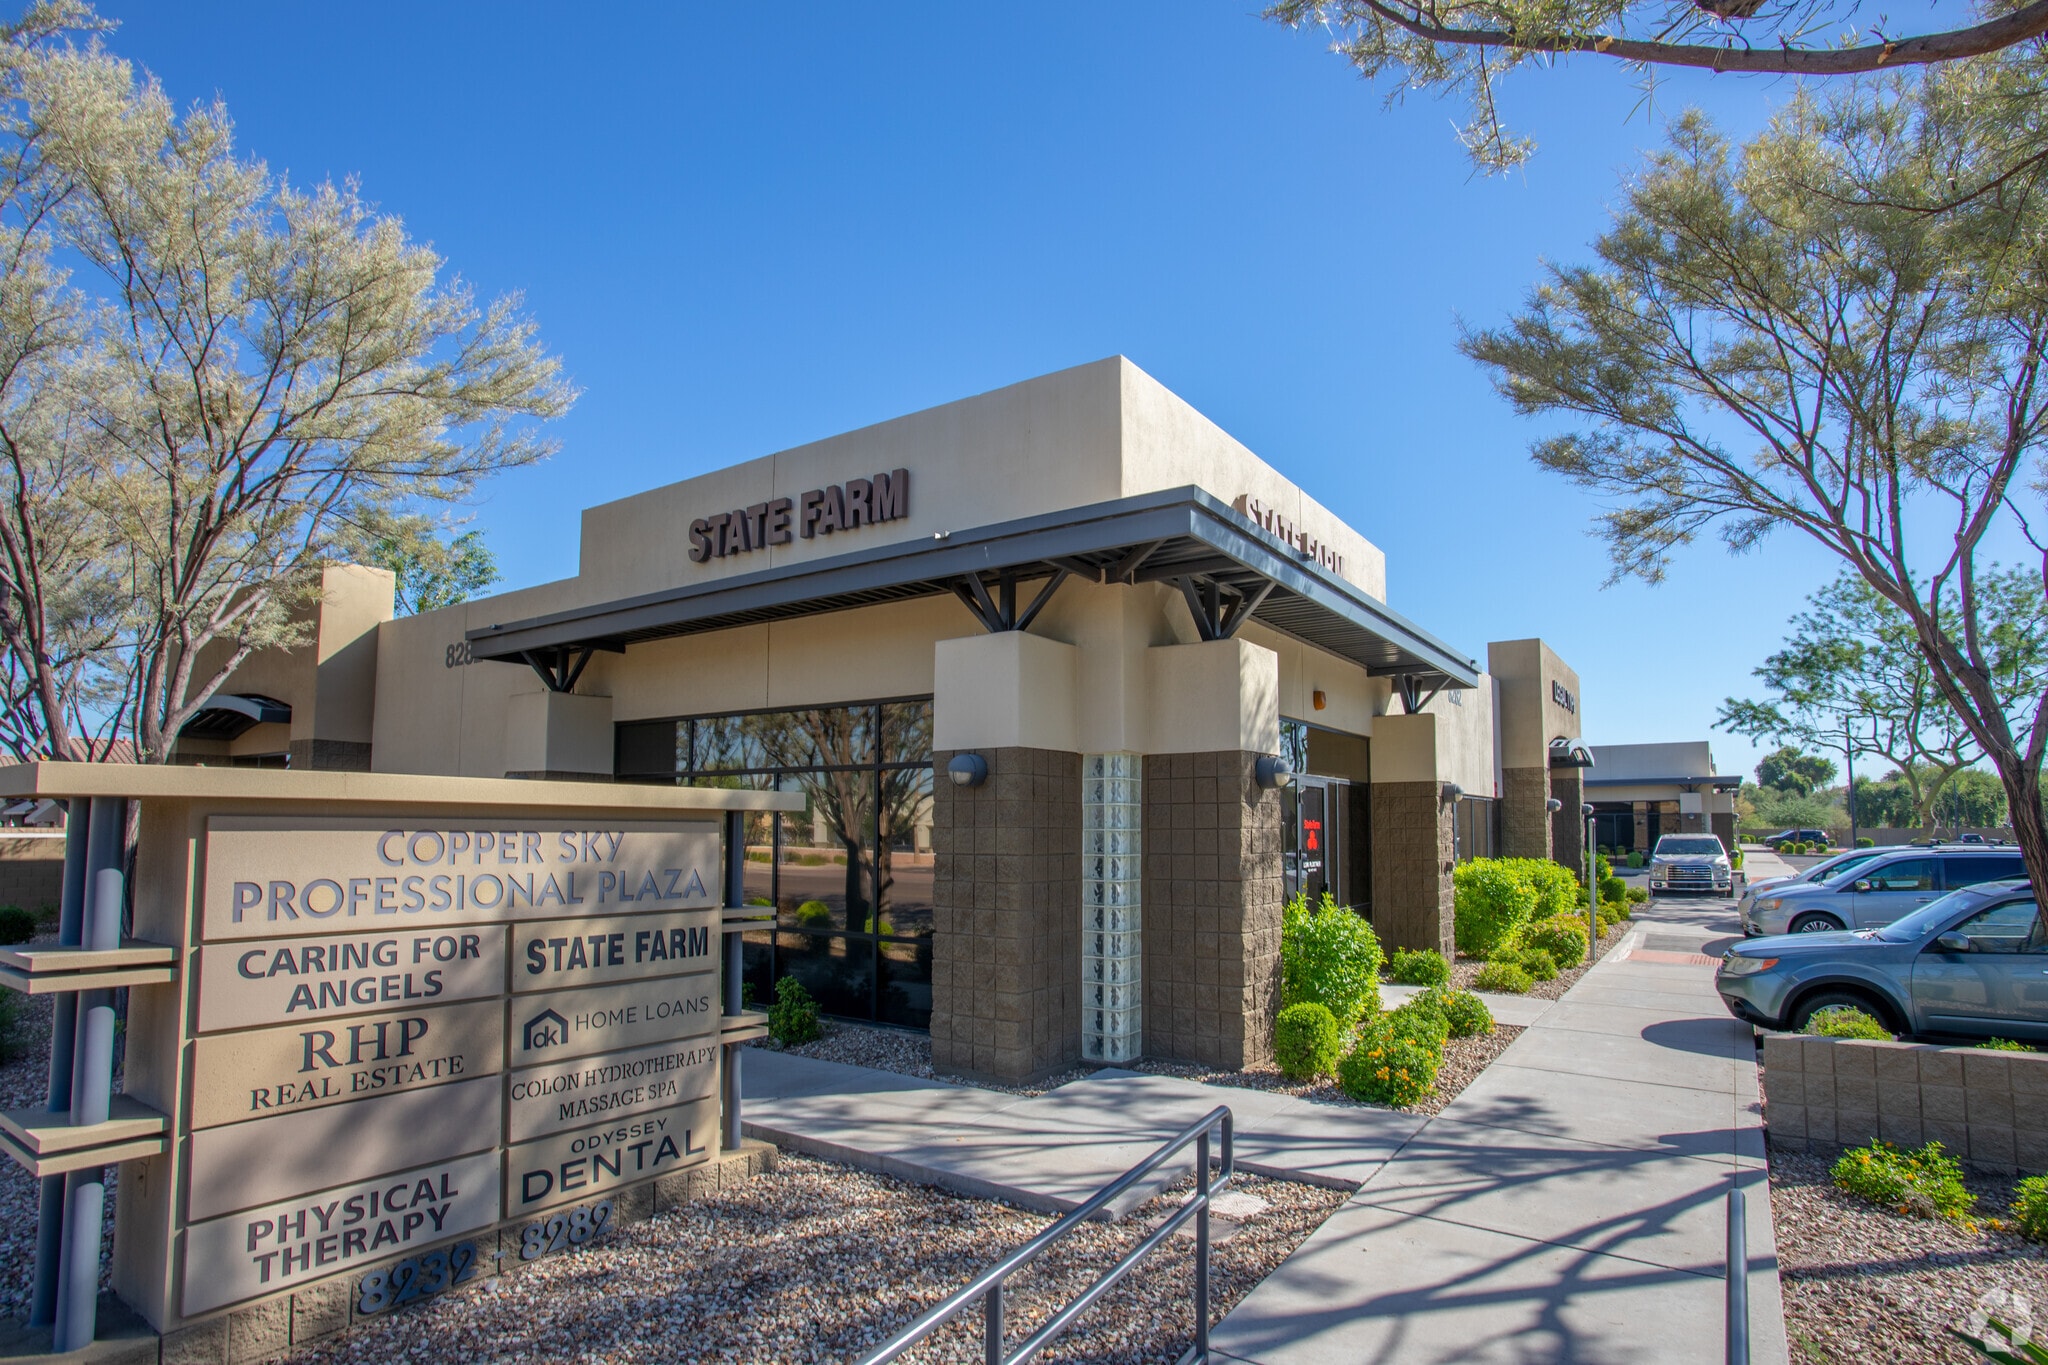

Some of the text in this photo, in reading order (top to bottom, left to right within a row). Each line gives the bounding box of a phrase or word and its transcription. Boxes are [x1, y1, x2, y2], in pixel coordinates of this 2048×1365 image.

[688, 468, 908, 562] STATE FARM
[446, 640, 483, 668] 828
[376, 829, 625, 867] COPPER SKY
[232, 868, 707, 923] PROFESSIONAL PLAZA
[237, 934, 481, 980] CARING FOR
[526, 926, 709, 975] STATE FARM
[285, 970, 443, 1013] ANGELS
[575, 1006, 638, 1032] HOME
[645, 995, 710, 1021] LOANS
[298, 1017, 429, 1073] RHP
[250, 1055, 464, 1111] REAL ESTATE
[511, 1046, 716, 1101] COLON HYDROTHERAPY
[559, 1080, 678, 1121] MASSAGE SPA
[571, 1117, 668, 1154] ODYSSEY
[522, 1129, 706, 1204] DENTAL
[247, 1173, 459, 1252] PHYSICAL
[253, 1202, 451, 1284] THERAPY
[358, 1239, 479, 1314] 8232
[521, 1200, 615, 1261] 8282
